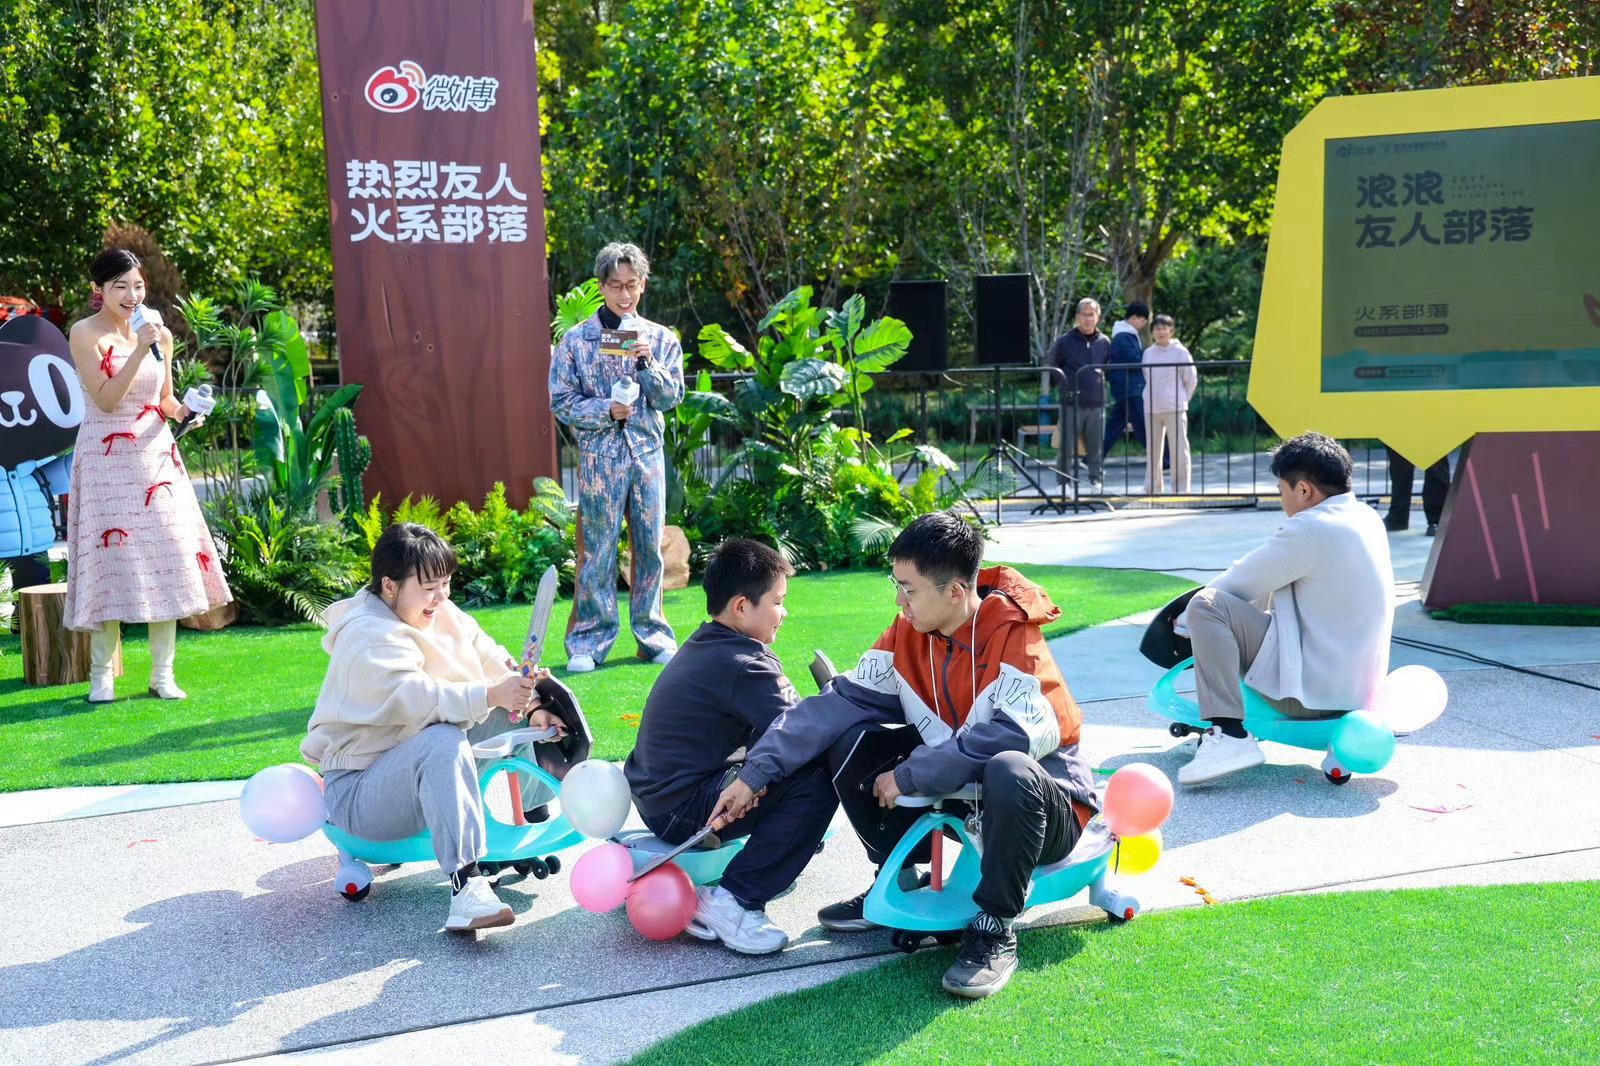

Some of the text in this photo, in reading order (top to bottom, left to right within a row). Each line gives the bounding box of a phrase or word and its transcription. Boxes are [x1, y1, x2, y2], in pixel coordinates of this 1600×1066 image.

[425, 76, 498, 111] 微博
[346, 159, 527, 200] 热烈友人
[1355, 170, 1445, 208] 浪浪
[351, 203, 527, 243] 火系部落
[1355, 206, 1535, 249] 友人部落
[1355, 304, 1449, 321] 火系部落
